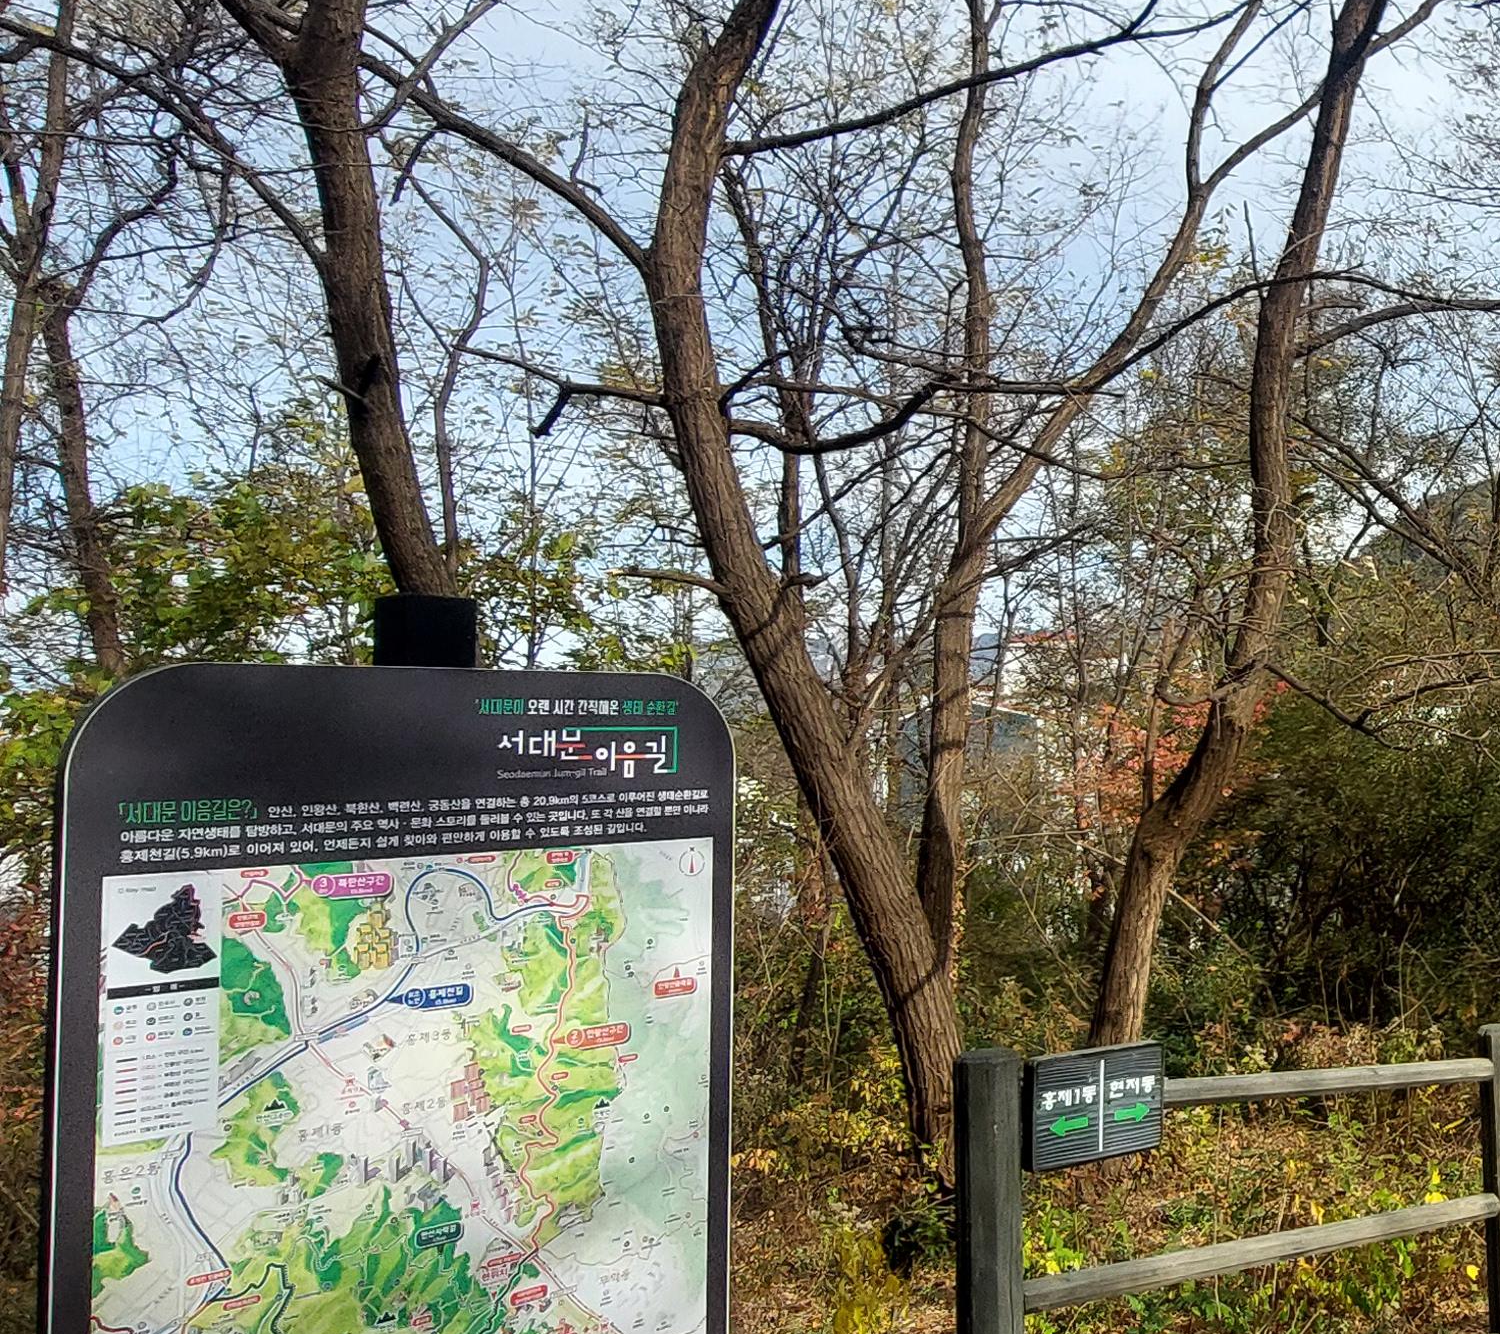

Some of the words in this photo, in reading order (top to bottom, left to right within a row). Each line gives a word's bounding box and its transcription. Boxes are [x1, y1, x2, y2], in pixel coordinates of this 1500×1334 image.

[527, 699, 550, 715] 오랜
[553, 699, 574, 715] 시간
[577, 699, 619, 715] 간직해온
[622, 700, 643, 715] 생태
[497, 729, 590, 761] 서대문
[595, 735, 667, 778] 이음길
[497, 769, 551, 779] Seodaemun
[588, 768, 608, 776] Trail
[428, 798, 472, 811] 궁동산을
[475, 797, 517, 809] 연결하는
[618, 791, 655, 803] 이루어진
[120, 828, 175, 843] 아름다운
[178, 825, 242, 841] 자연생태를
[301, 820, 348, 835] 서대문의
[350, 819, 375, 832] 주요
[435, 814, 477, 827] 스토리를
[512, 812, 523, 824] 수
[526, 811, 546, 823] 있는
[548, 809, 589, 822] 곳입니다.
[246, 841, 286, 856] 이어져
[323, 836, 372, 851] 언제든지
[403, 833, 438, 847] 찾아와
[441, 830, 485, 844] 편안하게
[489, 828, 521, 842] 이용할
[525, 827, 536, 839] 수
[1041, 1085, 1097, 1111] 홍제1동
[1109, 1075, 1156, 1099] 현저동
